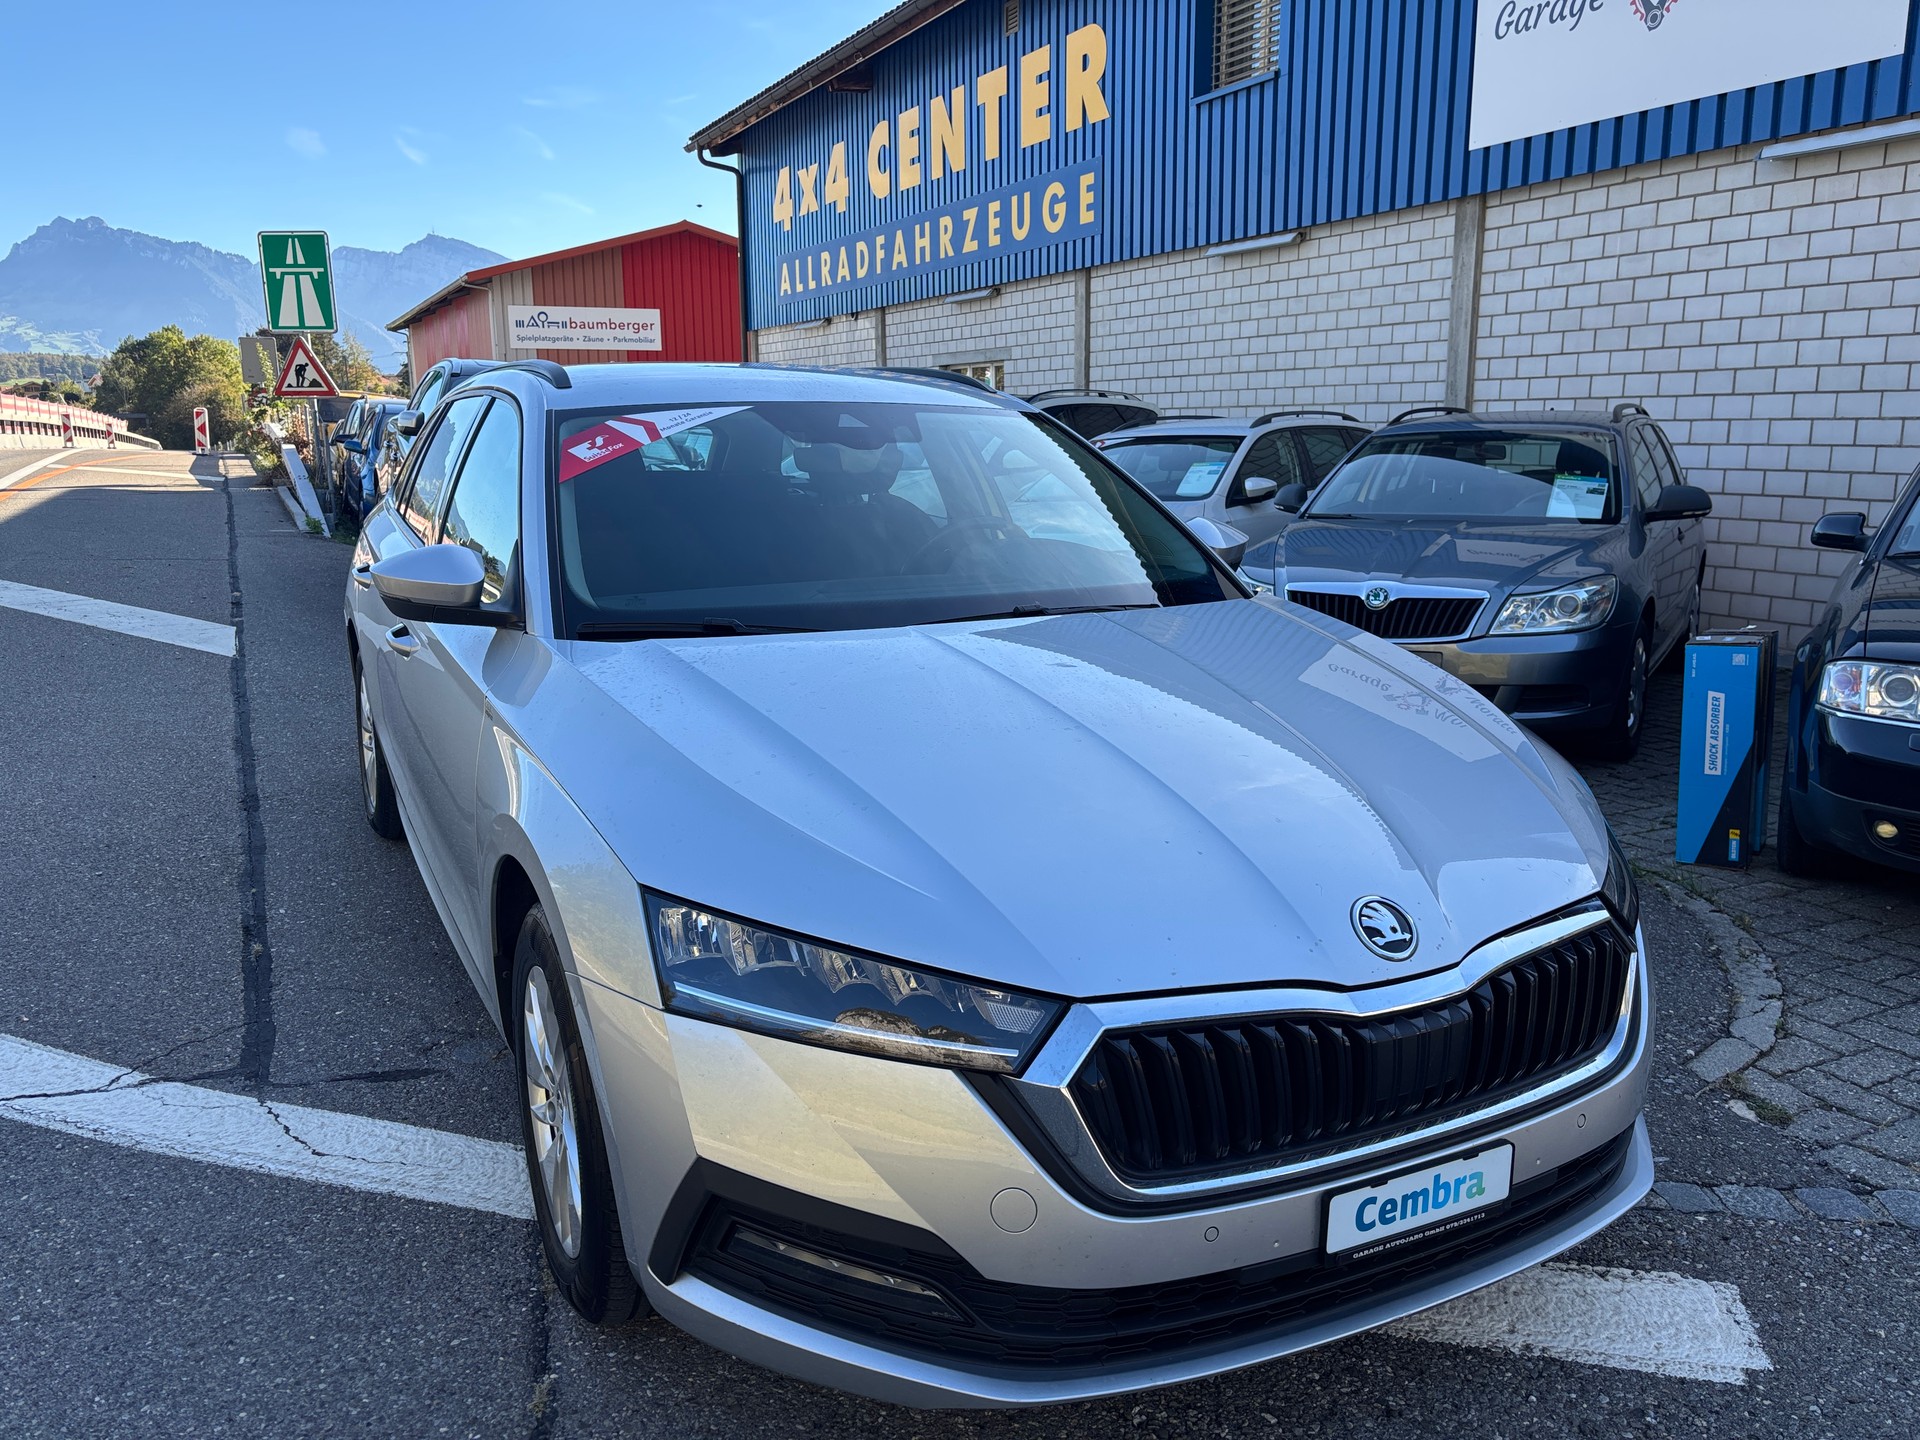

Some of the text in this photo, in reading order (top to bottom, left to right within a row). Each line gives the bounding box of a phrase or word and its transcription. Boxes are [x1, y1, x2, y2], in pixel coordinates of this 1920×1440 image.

[773, 23, 1111, 232] 4x4 CENTER
[780, 172, 1096, 297] ALLRADFAHRZEUGE
[516, 334, 656, 344] Spielplatzgeräte Zäune Parkmobiliar
[569, 317, 655, 334] baumberger
[1708, 695, 1721, 771] SHOCK ABSORBER
[1355, 1171, 1486, 1233] Cembra
[1353, 1244, 1384, 1259] GARAGE
[1424, 1225, 1445, 1236] GmbH
